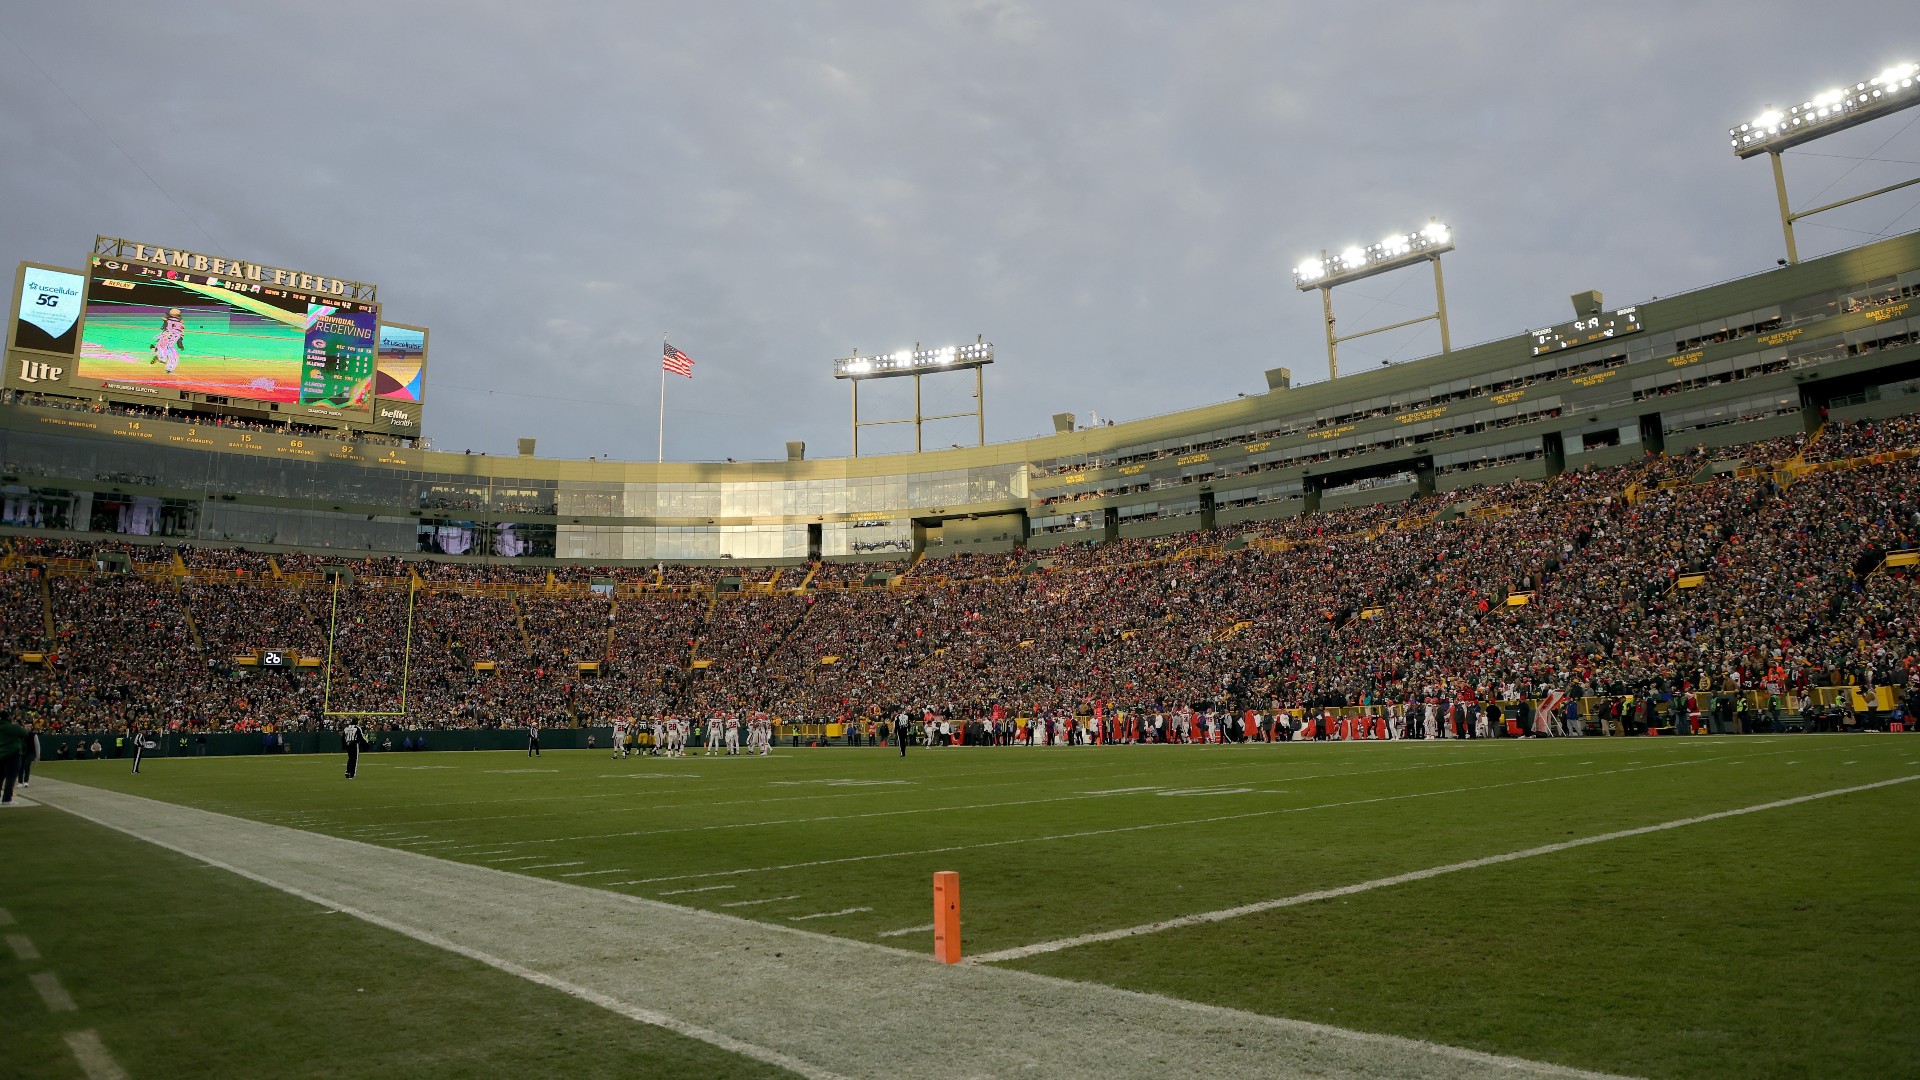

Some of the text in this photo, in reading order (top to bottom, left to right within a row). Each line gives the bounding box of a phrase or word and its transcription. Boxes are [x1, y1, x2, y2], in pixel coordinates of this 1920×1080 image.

[135, 244, 345, 296] LAMBEAU FIELD
[108, 280, 131, 289] REPLAY
[38, 285, 79, 296] uscellular
[35, 293, 60, 308] 5G
[341, 301, 352, 309] 42
[1865, 303, 1909, 319] BART STARR
[316, 315, 355, 327] INDIVIDUAL
[315, 321, 372, 339] RECEIVING
[1603, 328, 1614, 337] 42
[18, 359, 63, 383] Lite
[135, 386, 159, 394] ELECTRIC
[380, 408, 408, 420] bellin
[68, 420, 97, 429] NUMBERS
[128, 421, 140, 430] 14
[390, 417, 413, 428] health
[188, 428, 196, 436] 3
[240, 434, 252, 442] 15
[290, 439, 303, 448] 66
[341, 445, 354, 453] 92
[389, 450, 396, 458] 4
[265, 652, 281, 664] 26
